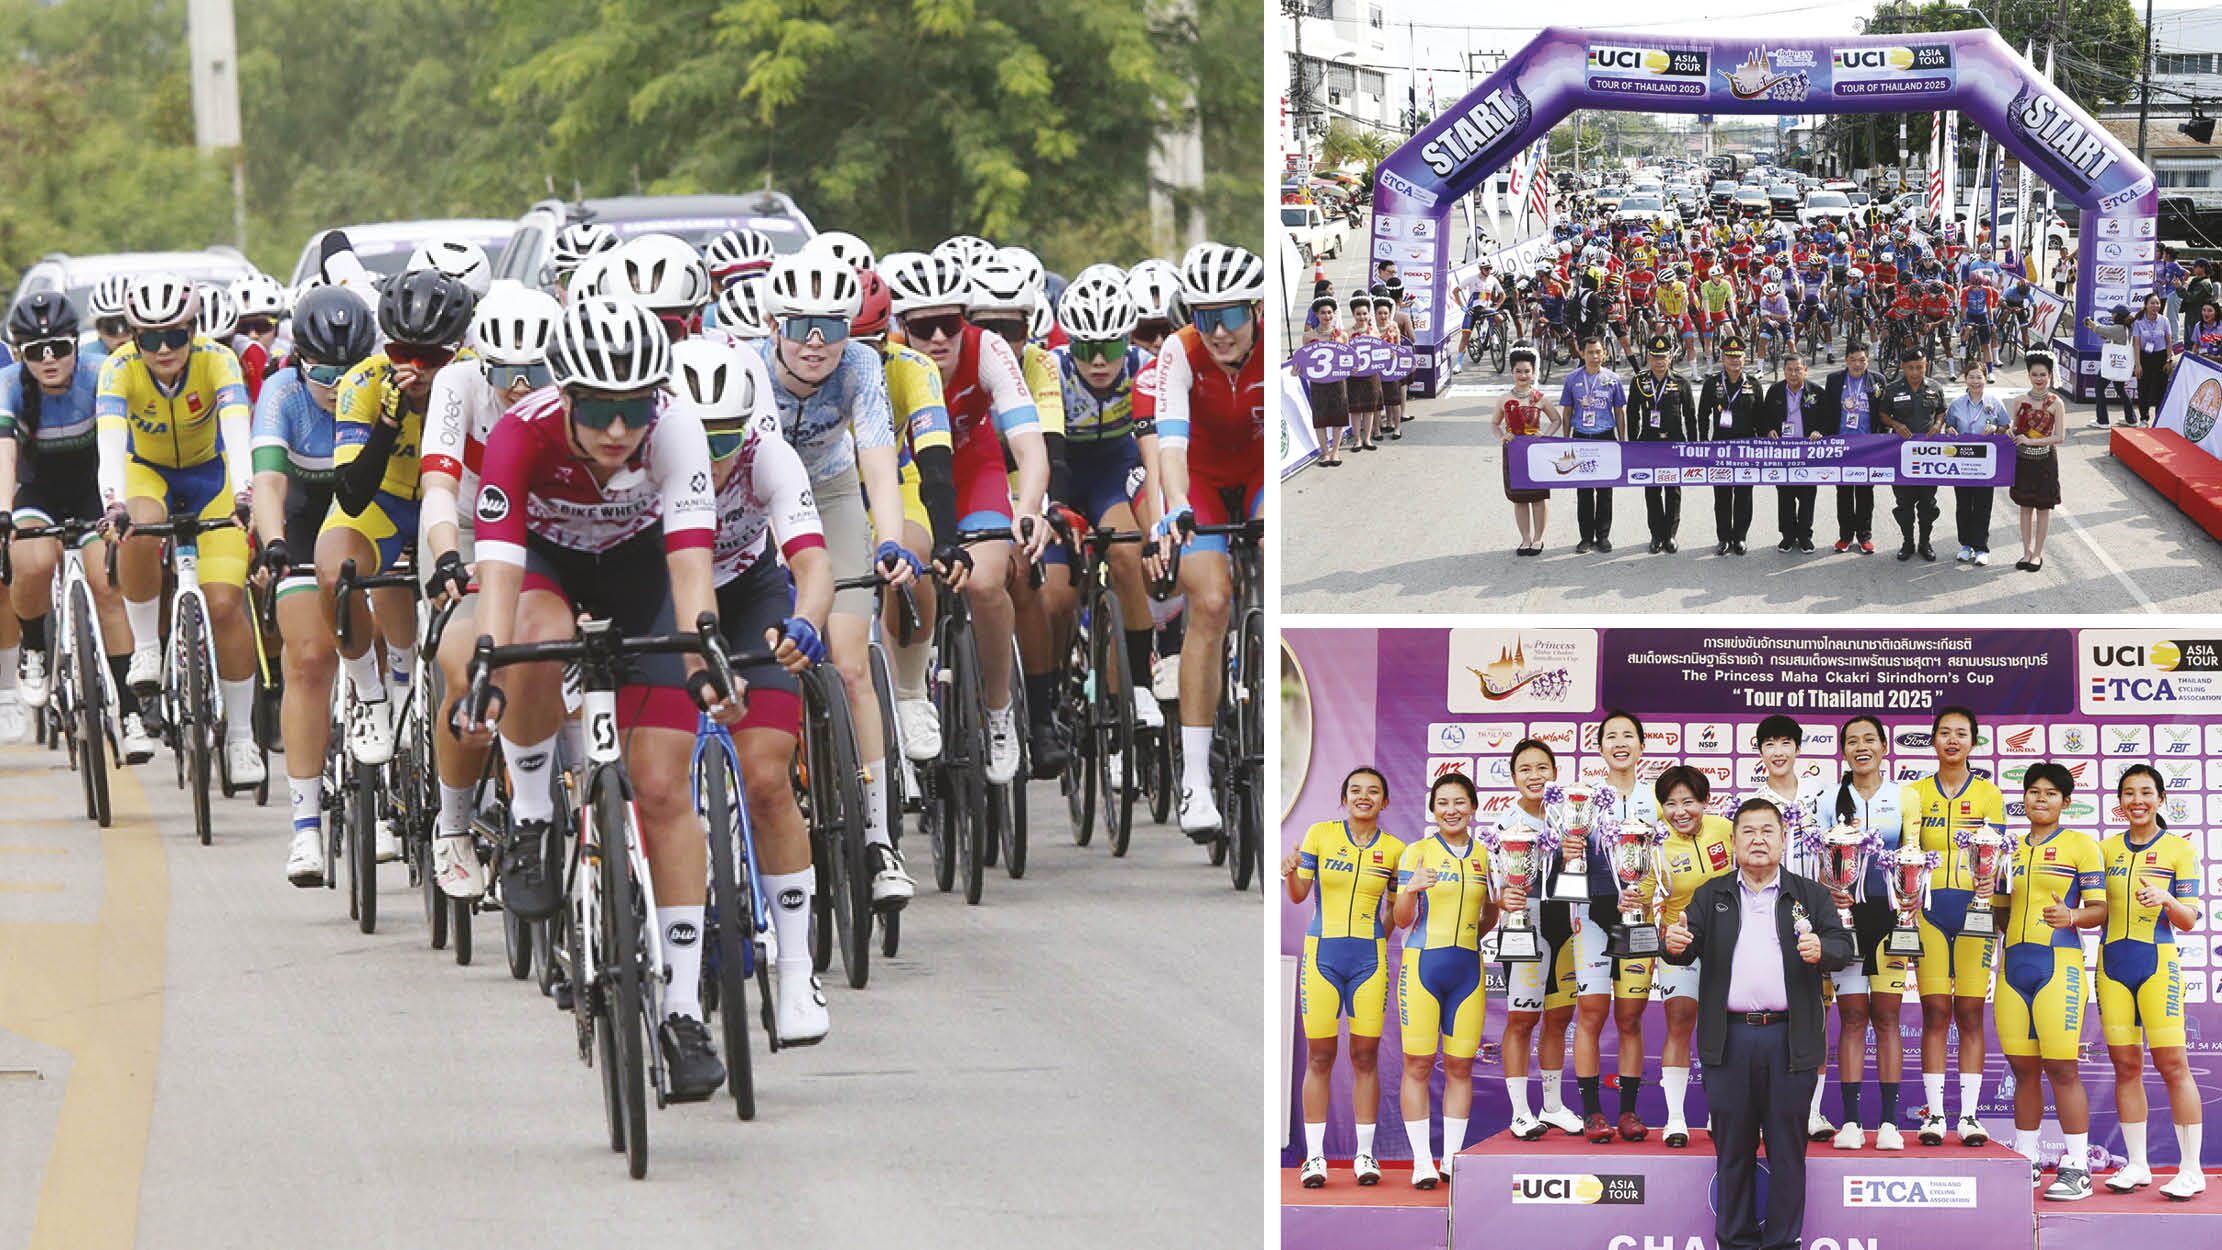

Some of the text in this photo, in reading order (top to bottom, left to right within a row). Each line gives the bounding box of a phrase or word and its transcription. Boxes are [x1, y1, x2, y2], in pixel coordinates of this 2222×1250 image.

[1598, 50, 1640, 69] UCI
[1674, 54, 1696, 64] ASIA
[1842, 50, 1885, 69] UCI
[1918, 49, 1942, 59] ASIA
[1674, 62, 1701, 72] TOUR
[1918, 56, 1946, 67] TOUR
[1595, 79, 1701, 93] TOUR OF THAILAND 2025
[1841, 80, 1946, 94] TOUR OF THAILAND 2025
[1421, 88, 1516, 176] START
[2022, 95, 2119, 180] START
[1306, 348, 1334, 378] 3
[1356, 345, 1372, 372] 5
[1717, 445, 1732, 458] of
[1738, 445, 1801, 459] Thailand
[1917, 446, 1941, 456] UCI
[1684, 468, 1704, 478] MK
[1921, 462, 1961, 475] TCA
[560, 504, 593, 517] BIKE
[1534, 639, 1576, 650] Princess
[1703, 636, 1972, 651] การแข่งขันจักรยานทางไกลนานาชาติเฉลิมพระเกียรติ
[2093, 645, 2145, 667] UCI
[2186, 645, 2215, 656] ASIA
[1627, 651, 2049, 670] สมเด็จพระกนิษฐาธิราชเจ้า กรมสมเด็จพระเทพรัตนราชสุดาฯ สยามบรมราชกุมารี
[2186, 656, 2219, 666] TOUR
[1682, 669, 1995, 686] The Princess Maha Ckakri Sirindhorn's Cup
[2108, 678, 2177, 701] TCA
[1744, 689, 1784, 707] Tour
[1787, 689, 1804, 707] of
[1808, 689, 1884, 708] Thailand
[1888, 689, 1933, 708] 2025
[1643, 732, 1664, 740] OKKA
[1811, 735, 1834, 744] AOT
[1903, 734, 1934, 747] Ford
[2113, 742, 2140, 753] FBT
[2166, 742, 2192, 753] FBT
[1582, 767, 1609, 777] SAMYA
[2166, 777, 2192, 788] FBT
[1483, 796, 1516, 812] MK
[1920, 815, 1946, 828] THA
[1324, 858, 1354, 873] THA
[2107, 866, 2128, 877] THA
[1436, 871, 1460, 882] HA
[1485, 974, 1505, 986] BA
[1400, 964, 1409, 1027] THAILAND
[2166, 961, 2180, 1018] THAILAND
[2065, 966, 2081, 1031] THAILAND
[2043, 1141, 2065, 1149] Team
[1523, 1179, 1570, 1199] UCI
[1609, 1180, 1635, 1189] ASIA
[1609, 1190, 1639, 1200] TOUR
[1866, 1181, 1929, 1202] TCA
